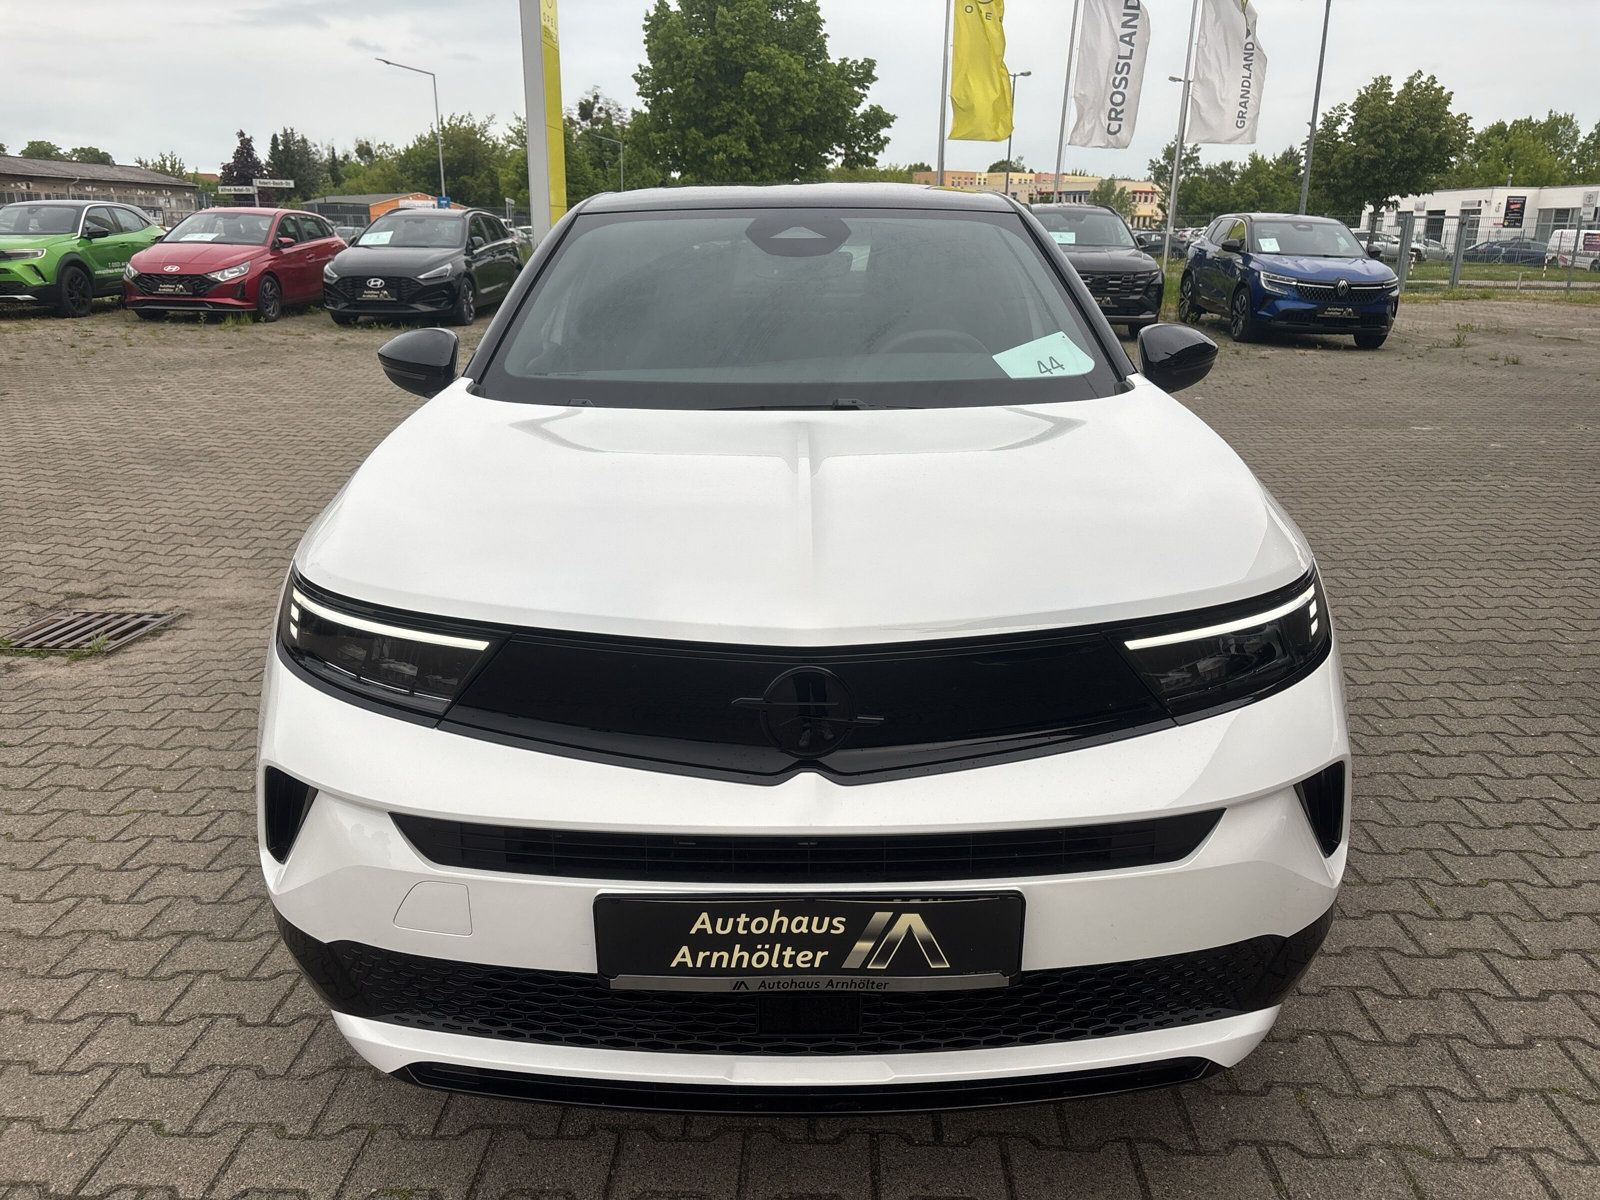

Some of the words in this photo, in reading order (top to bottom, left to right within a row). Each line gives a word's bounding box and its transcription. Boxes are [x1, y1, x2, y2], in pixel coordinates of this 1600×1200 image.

[1106, 0, 1141, 136] CROSSLAND
[1235, 41, 1255, 130] GRANDLAND
[1036, 355, 1066, 375] 44
[689, 909, 847, 935] Autohaus
[669, 943, 829, 969] Arnhölter
[757, 979, 821, 990] Autohaus
[824, 978, 890, 990] Arnhölter
